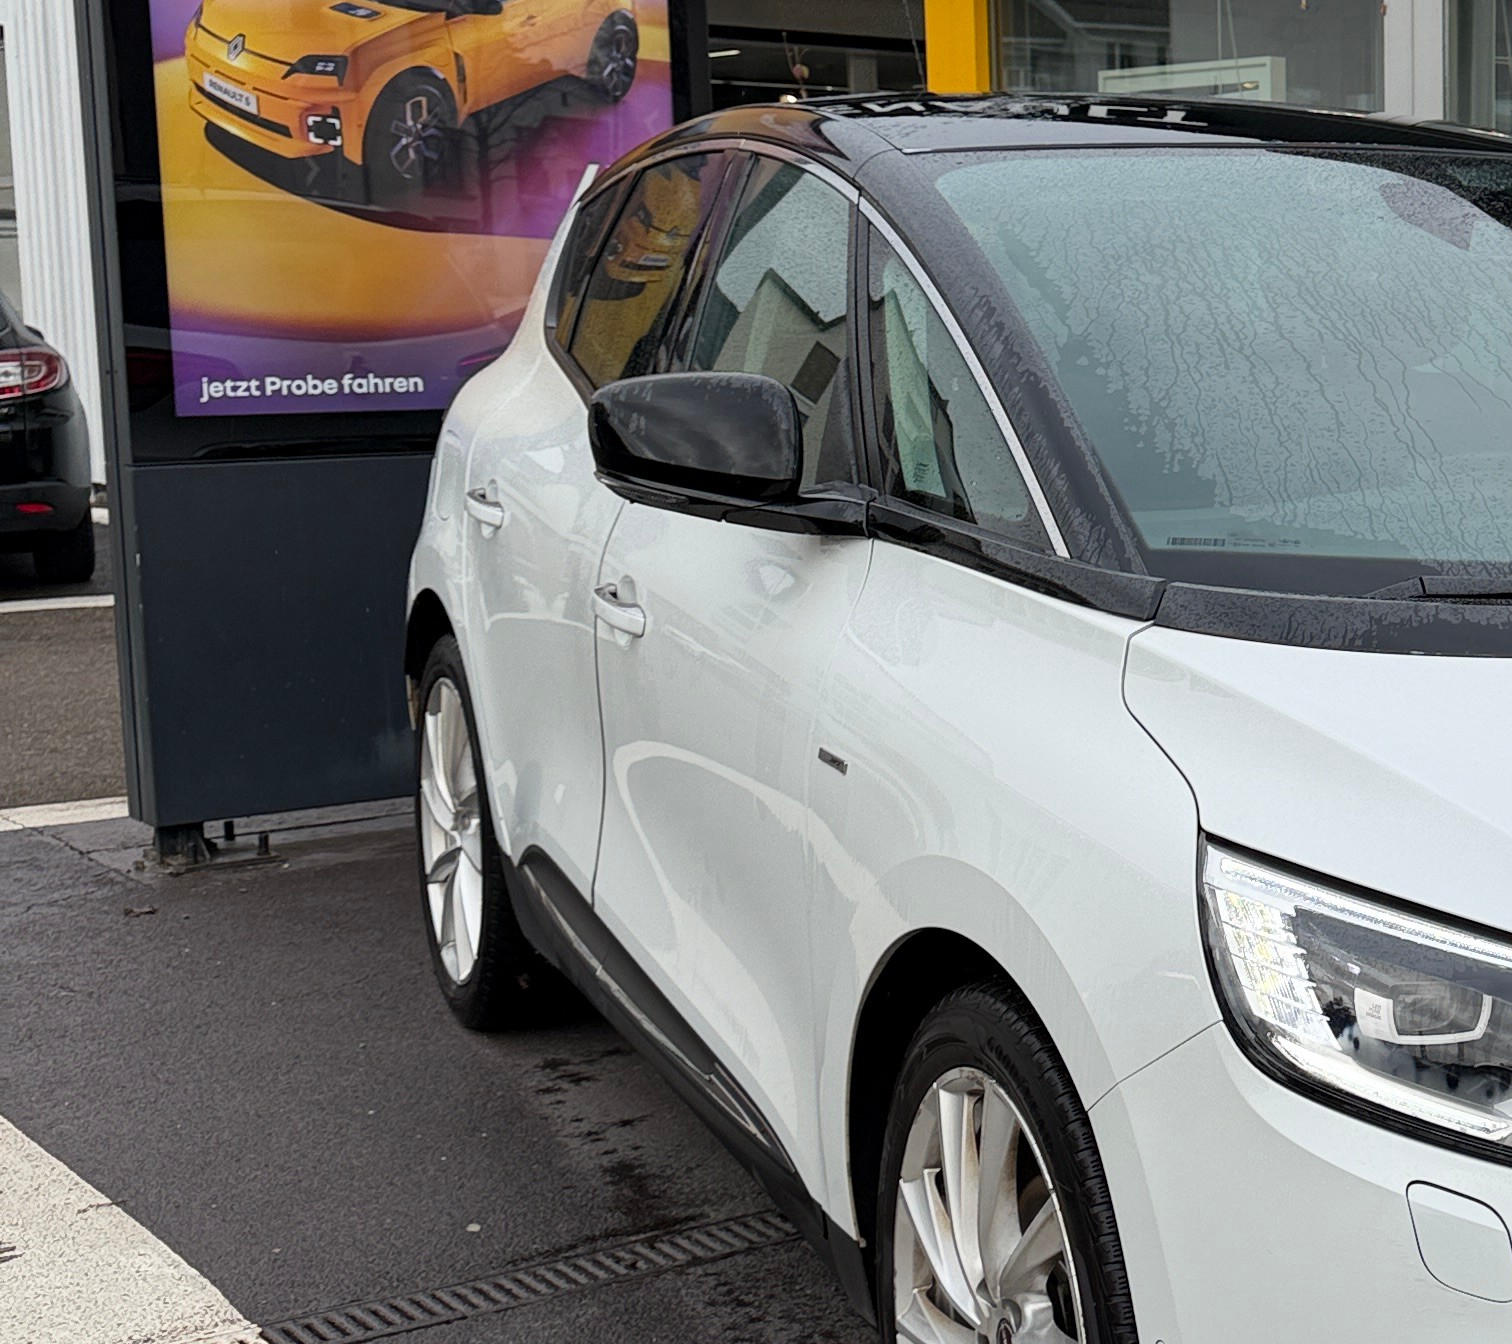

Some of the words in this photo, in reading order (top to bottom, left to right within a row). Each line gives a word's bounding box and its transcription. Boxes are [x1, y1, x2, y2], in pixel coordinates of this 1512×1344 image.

[200, 377, 261, 403] jetzt
[264, 374, 339, 396] Probe
[341, 372, 425, 395] fahren
